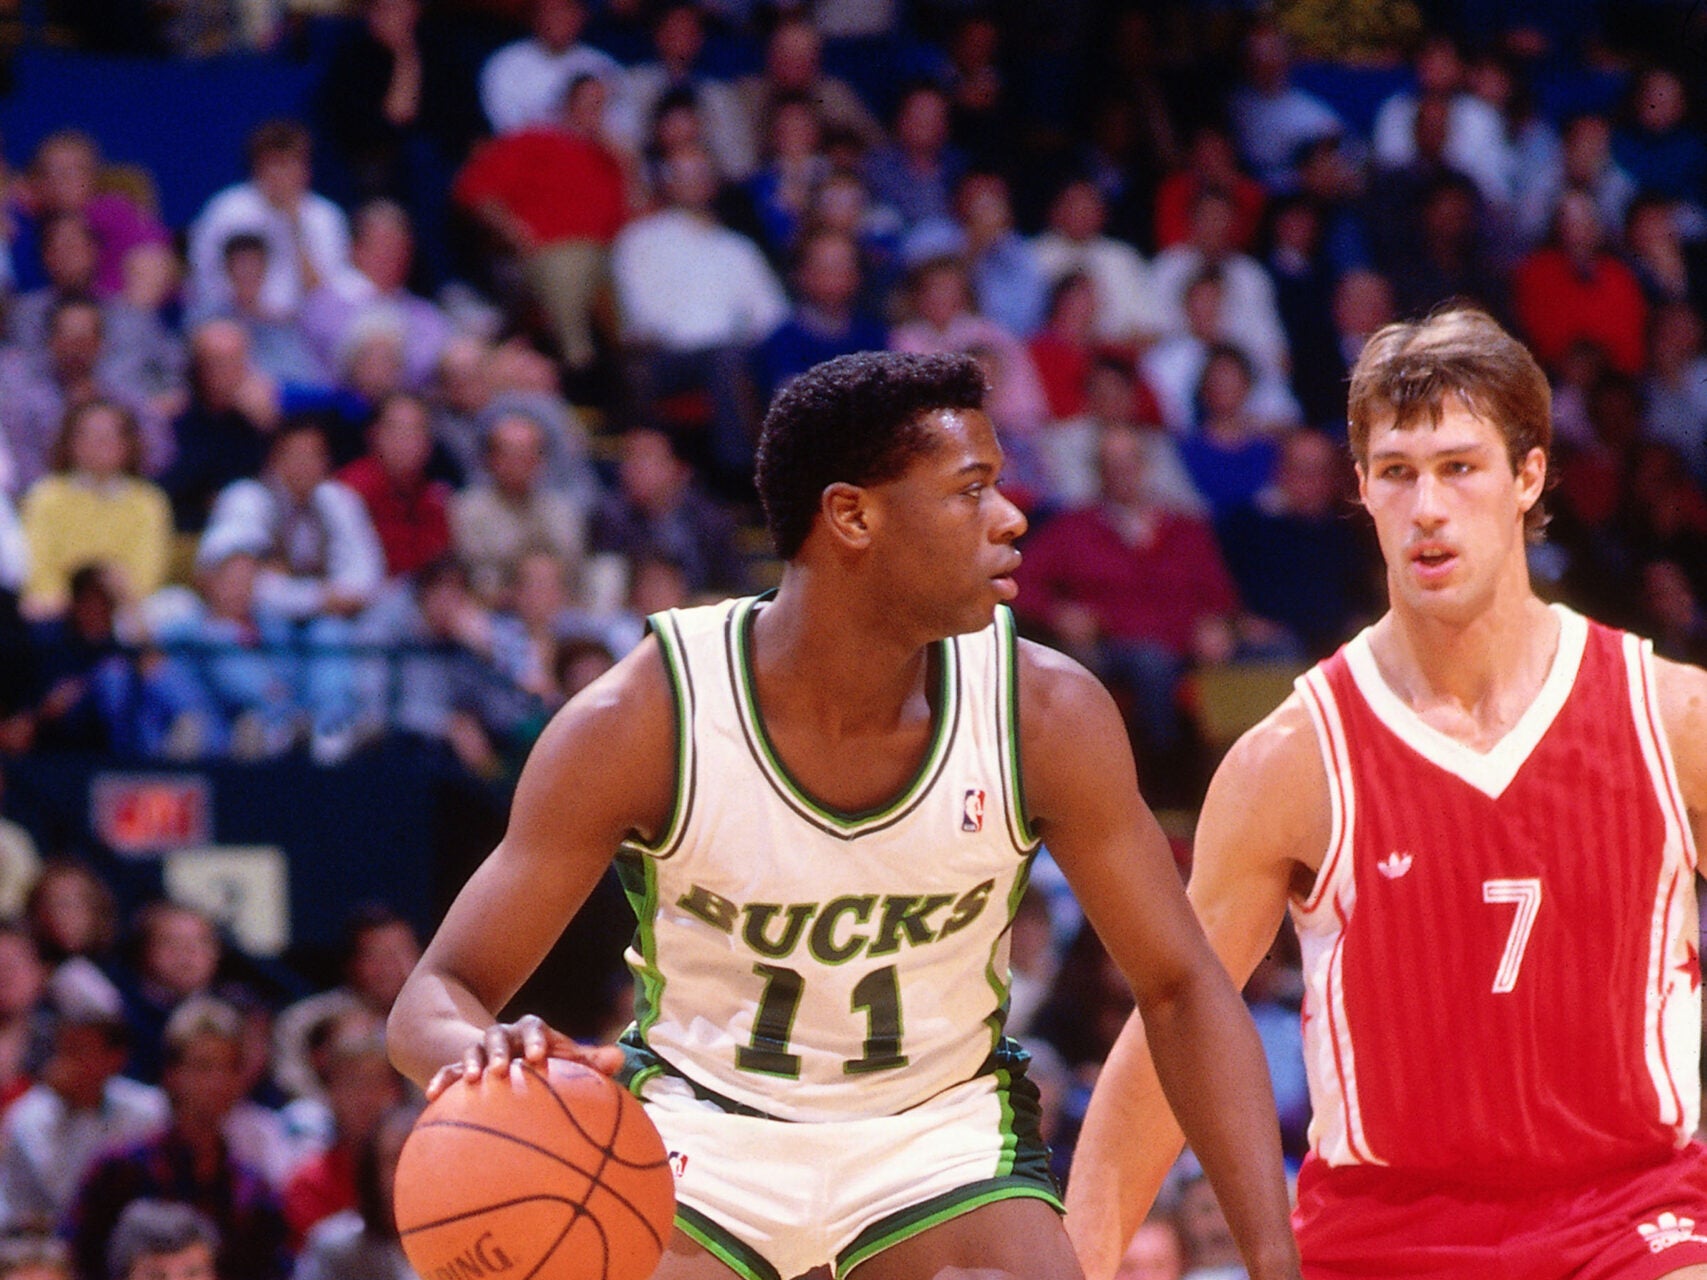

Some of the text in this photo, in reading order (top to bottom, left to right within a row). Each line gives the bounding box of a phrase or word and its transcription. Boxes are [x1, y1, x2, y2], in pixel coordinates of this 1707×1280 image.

[675, 877, 996, 967] BUCKS
[1481, 878, 1542, 994] 7
[734, 961, 909, 1080] 11
